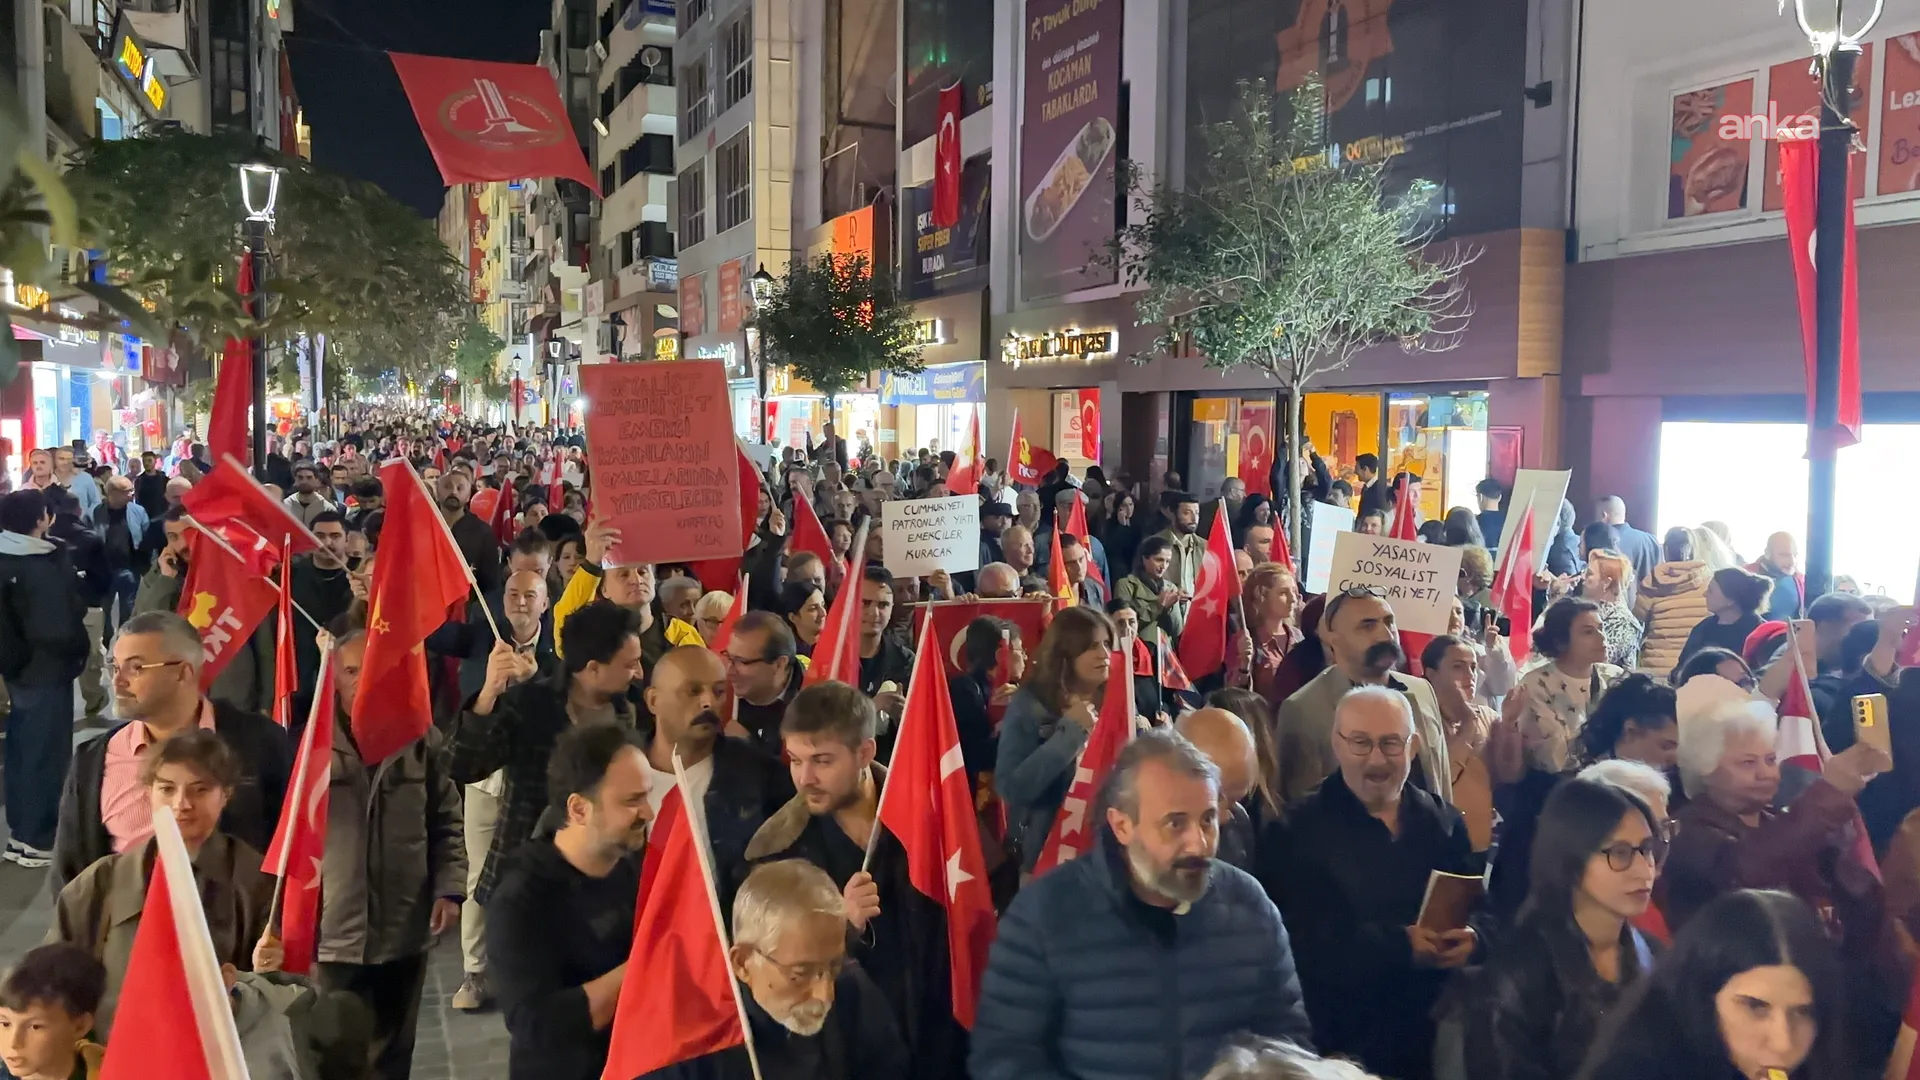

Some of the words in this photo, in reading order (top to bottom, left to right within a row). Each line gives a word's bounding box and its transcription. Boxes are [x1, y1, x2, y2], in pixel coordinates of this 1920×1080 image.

[1047, 54, 1091, 92] KOCAMAN
[1042, 80, 1098, 122] TABAKLARDA
[1018, 463, 1039, 479] TKP
[892, 516, 947, 531] PATRONLAR
[905, 547, 952, 561] KURACAK
[1372, 542, 1431, 564] YAŞASIN
[1352, 559, 1438, 584] SOSYALİST
[1339, 579, 1441, 608] CUMRİYET!
